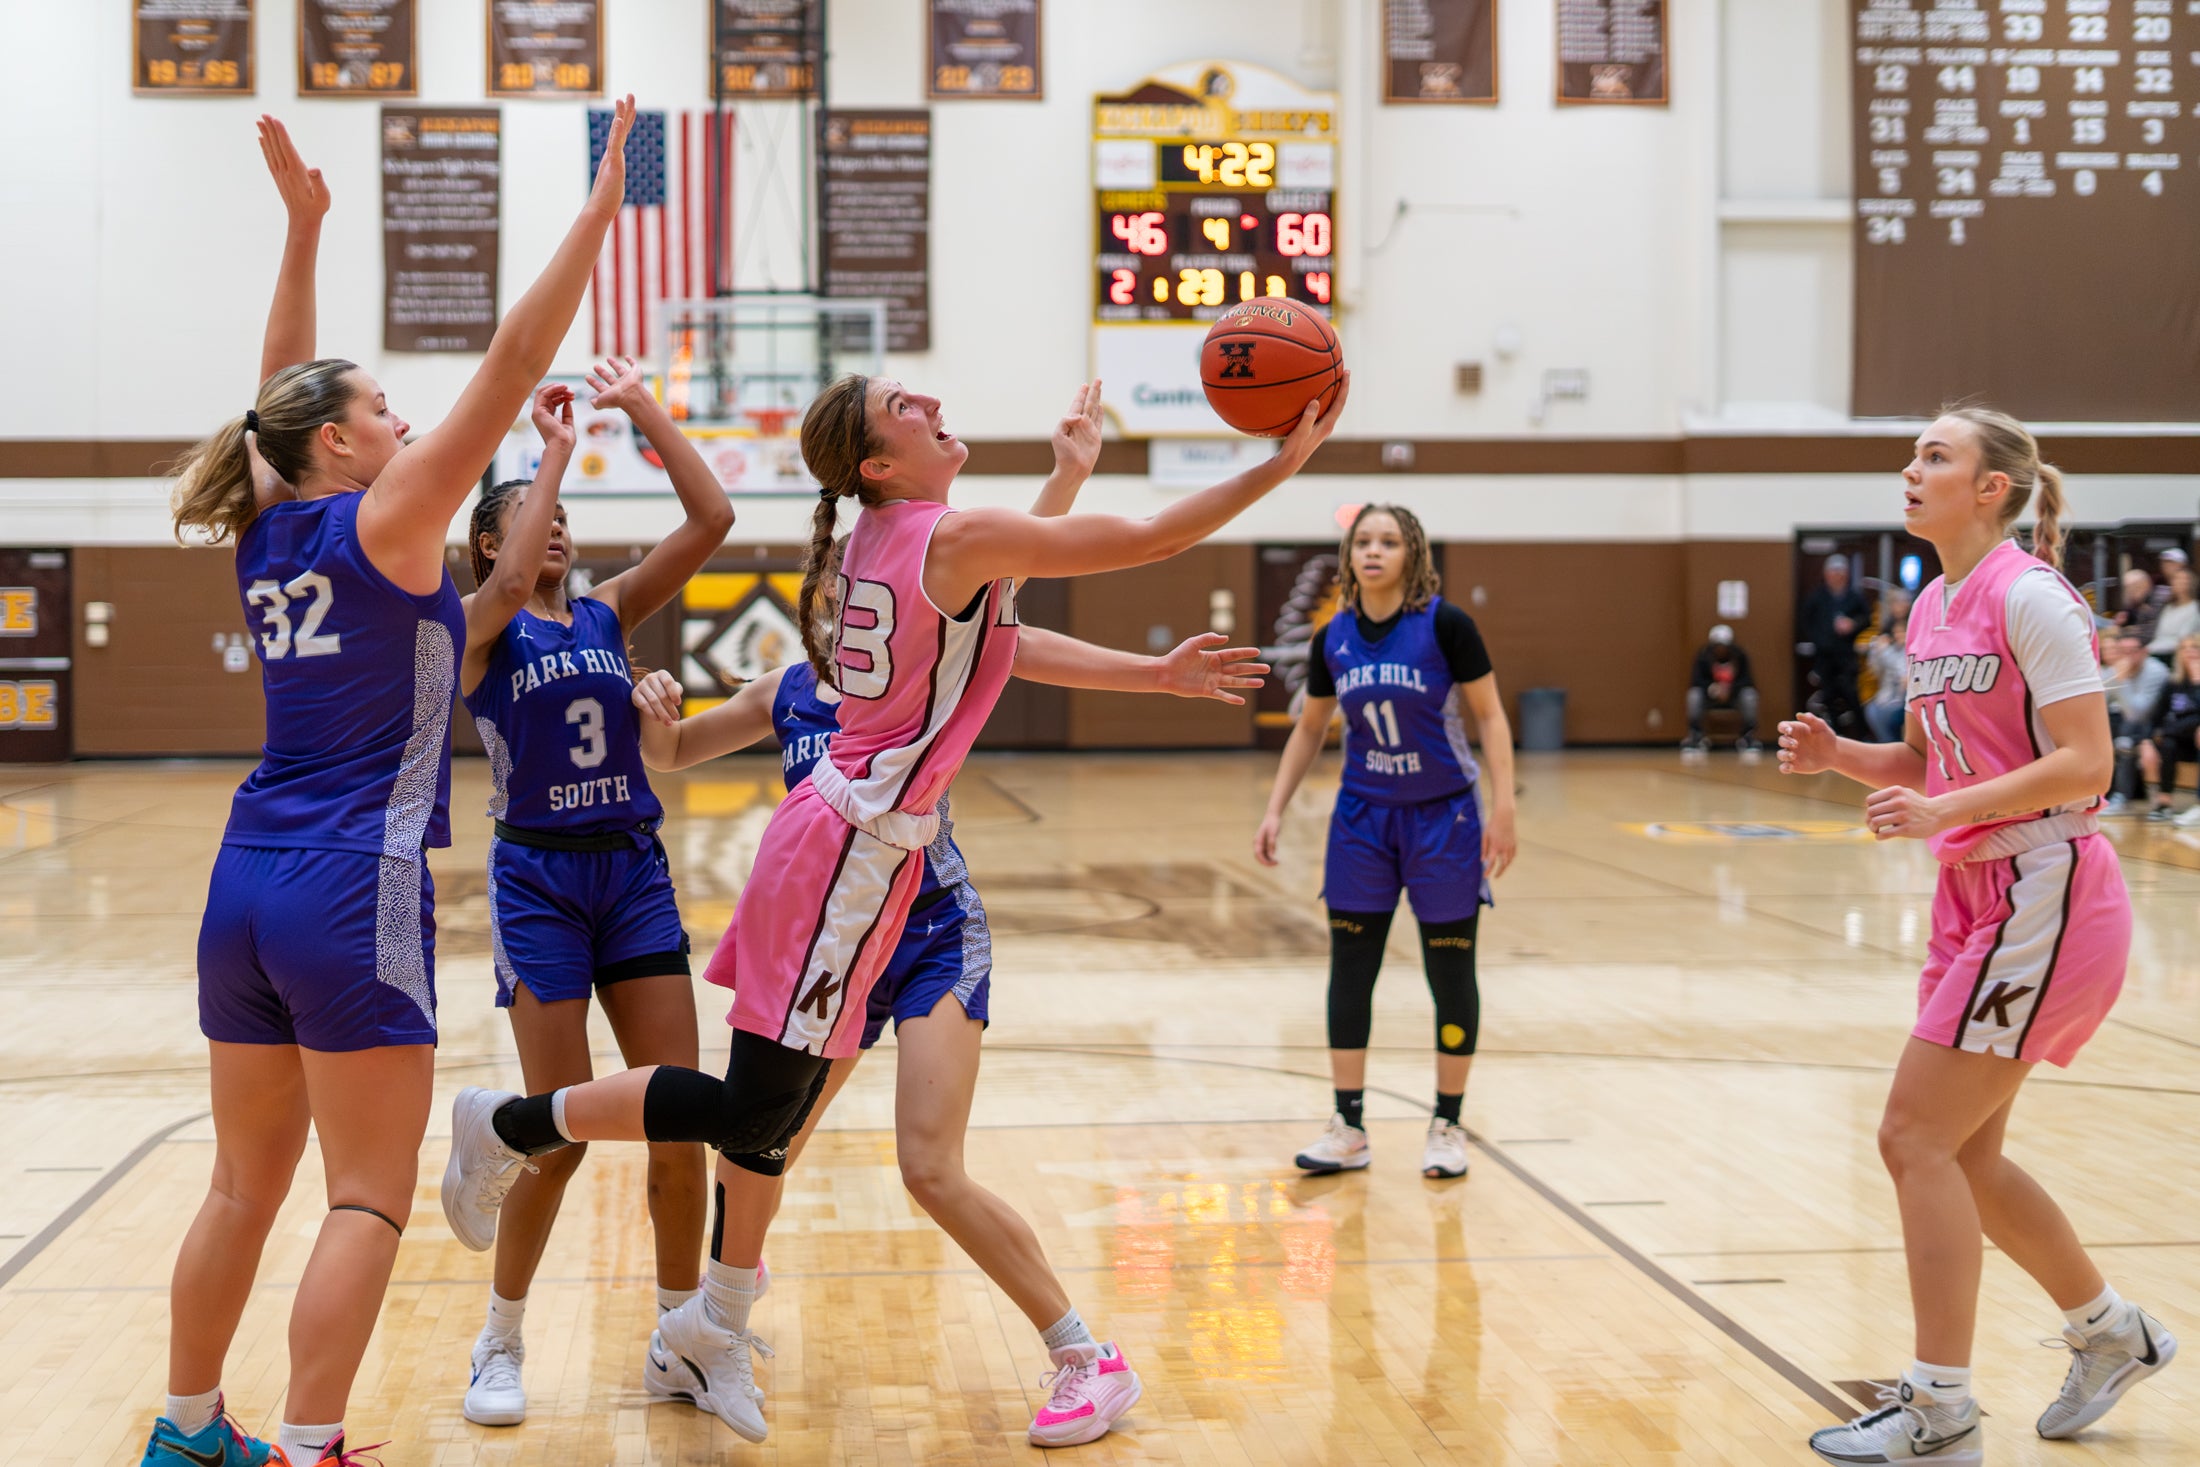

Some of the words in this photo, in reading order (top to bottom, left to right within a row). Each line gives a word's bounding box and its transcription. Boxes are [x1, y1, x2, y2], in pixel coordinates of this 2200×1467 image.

[1183, 142, 1275, 187] 4:22
[1112, 211, 1168, 256] 46
[1202, 217, 1230, 251] 4
[1276, 212, 1331, 257] 60
[1110, 268, 1136, 305] 2
[1177, 268, 1225, 306] 23
[1305, 271, 1331, 304] 4
[1216, 305, 1293, 328] SPALD
[0, 587, 38, 637] E
[247, 570, 341, 660] 32
[836, 573, 897, 700] 3
[511, 651, 580, 702] PARK
[580, 649, 632, 687] HILL
[1335, 664, 1376, 701] PARK
[1379, 663, 1427, 694] HILL
[565, 696, 608, 770] 3
[1362, 700, 1402, 747] 11
[1920, 699, 1975, 780] 11
[1365, 749, 1422, 776] SOUTH
[550, 775, 631, 811] SOUTH
[797, 970, 841, 1019] K
[1971, 981, 2036, 1027] K
